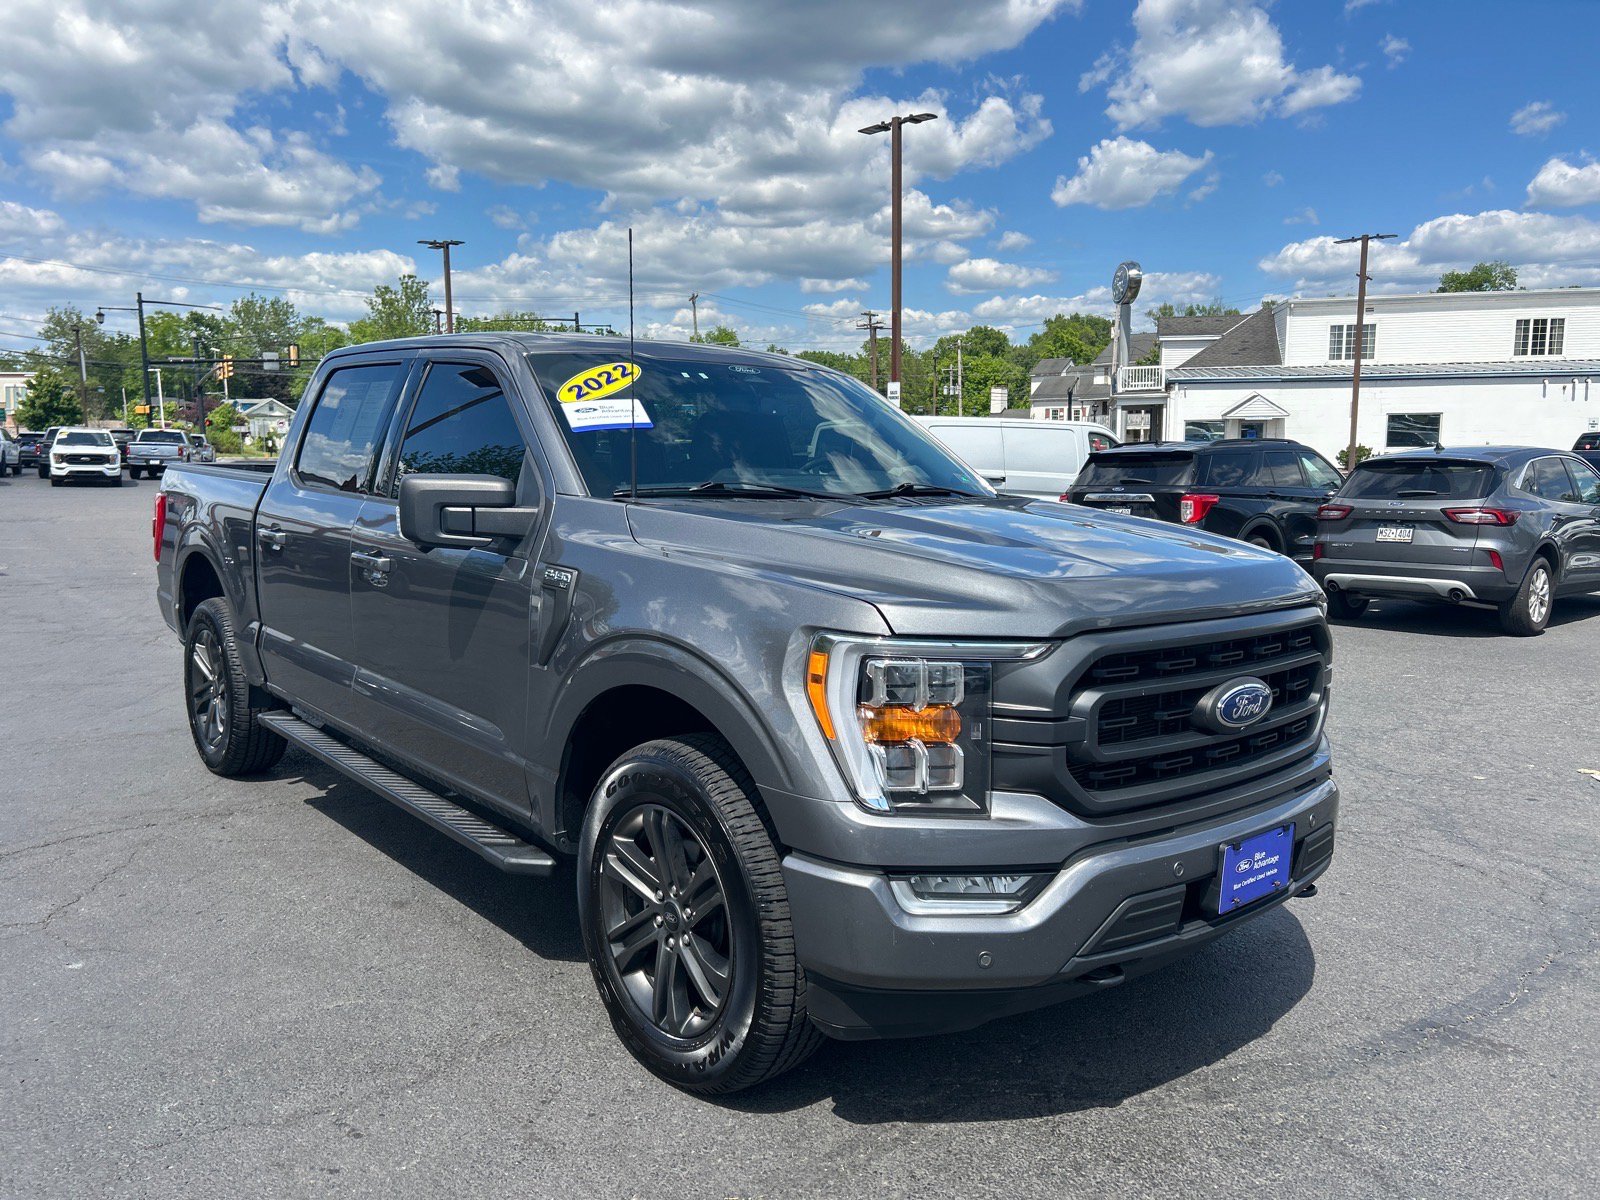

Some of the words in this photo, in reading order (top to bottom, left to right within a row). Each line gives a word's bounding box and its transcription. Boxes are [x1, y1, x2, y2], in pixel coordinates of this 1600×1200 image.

[567, 364, 633, 400] 2022
[1232, 694, 1263, 719] Ford
[1253, 855, 1279, 870] Advantage
[1254, 851, 1265, 861] Blue
[1242, 876, 1256, 886] Certified
[1257, 872, 1266, 880] Used
[1266, 868, 1278, 876] Vehicle
